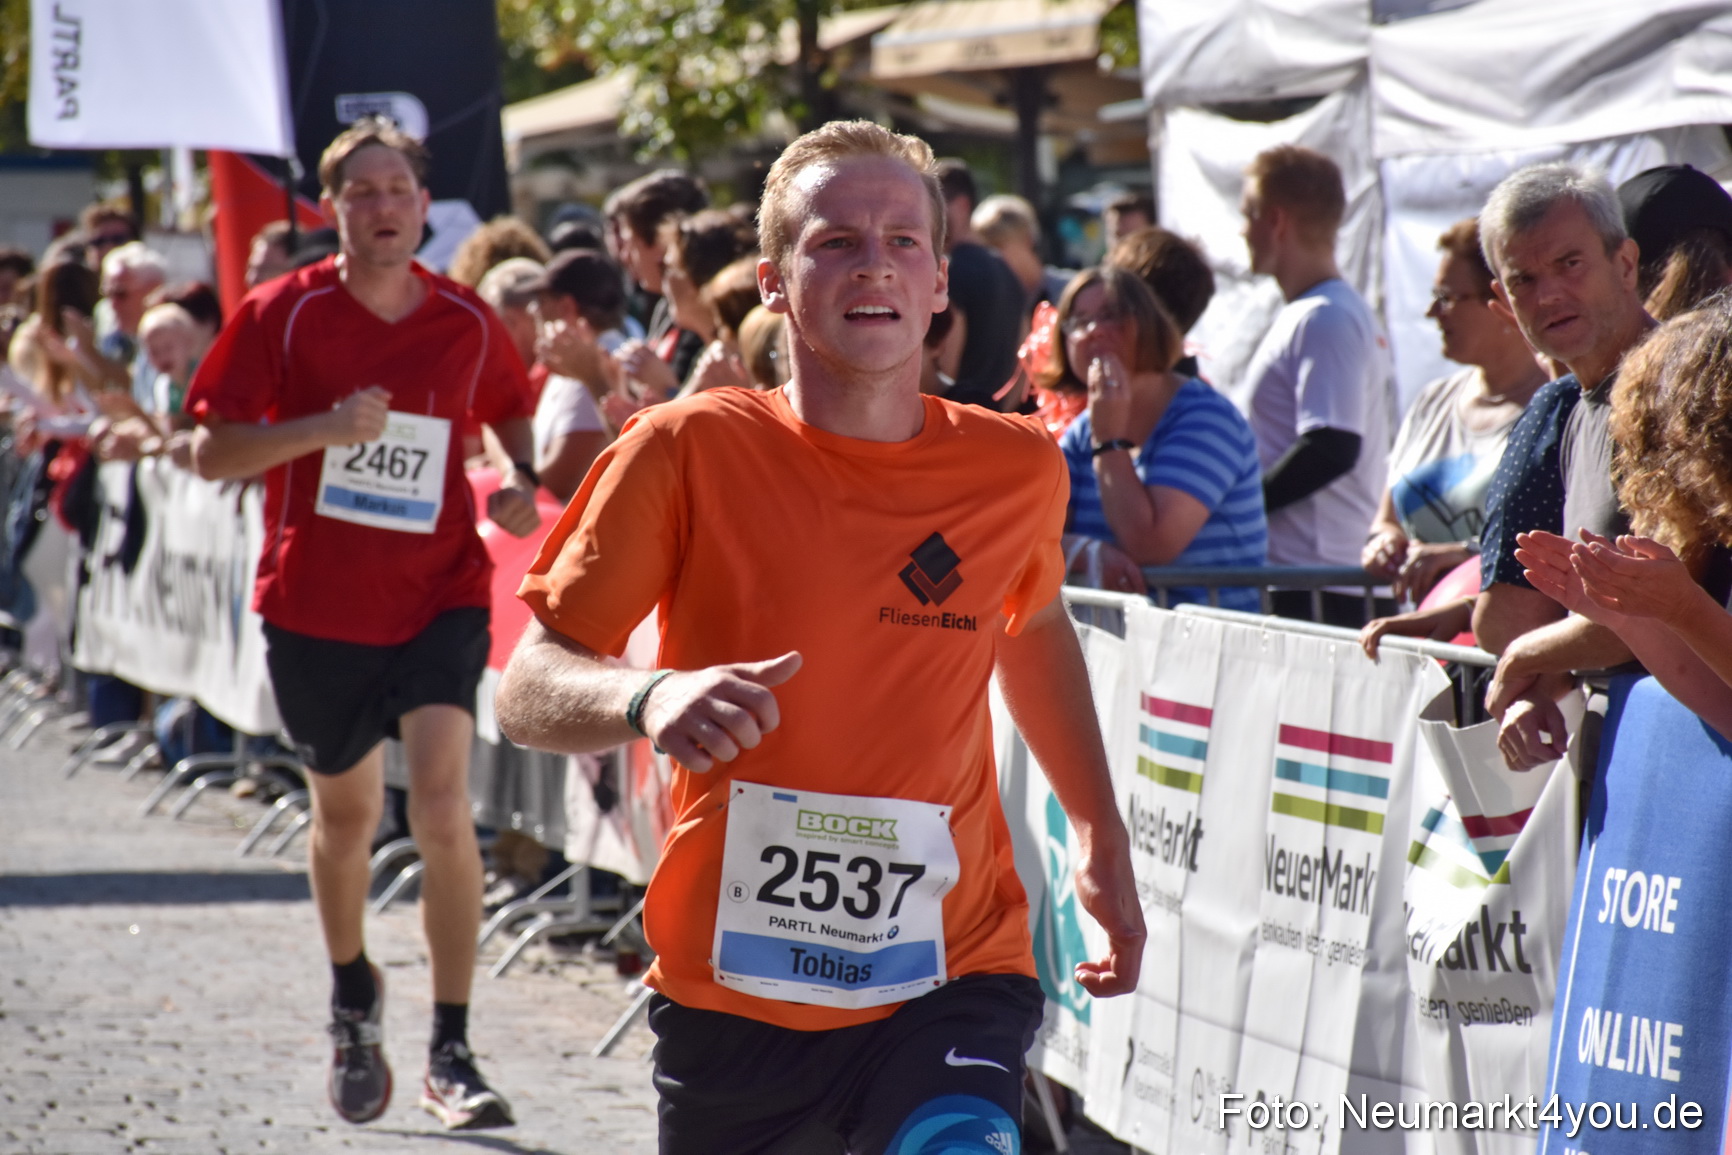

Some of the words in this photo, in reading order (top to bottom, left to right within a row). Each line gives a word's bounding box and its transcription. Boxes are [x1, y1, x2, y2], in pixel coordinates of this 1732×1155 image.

[344, 442, 429, 481] 2467
[354, 494, 407, 516] Markus
[879, 607, 977, 632] FliesenEichl
[797, 809, 898, 841] BOCK
[829, 835, 838, 843] by
[840, 838, 863, 846] smart
[865, 840, 900, 850] concepts
[756, 845, 926, 920] 2537
[1264, 833, 1377, 916] NeuerMark
[1598, 867, 1682, 934] STORE
[769, 916, 816, 934] PARTL
[820, 924, 884, 944] Neumarkt
[790, 947, 872, 984] Tobias
[1457, 997, 1533, 1027] genießen
[1578, 1006, 1683, 1082] ONLINE
